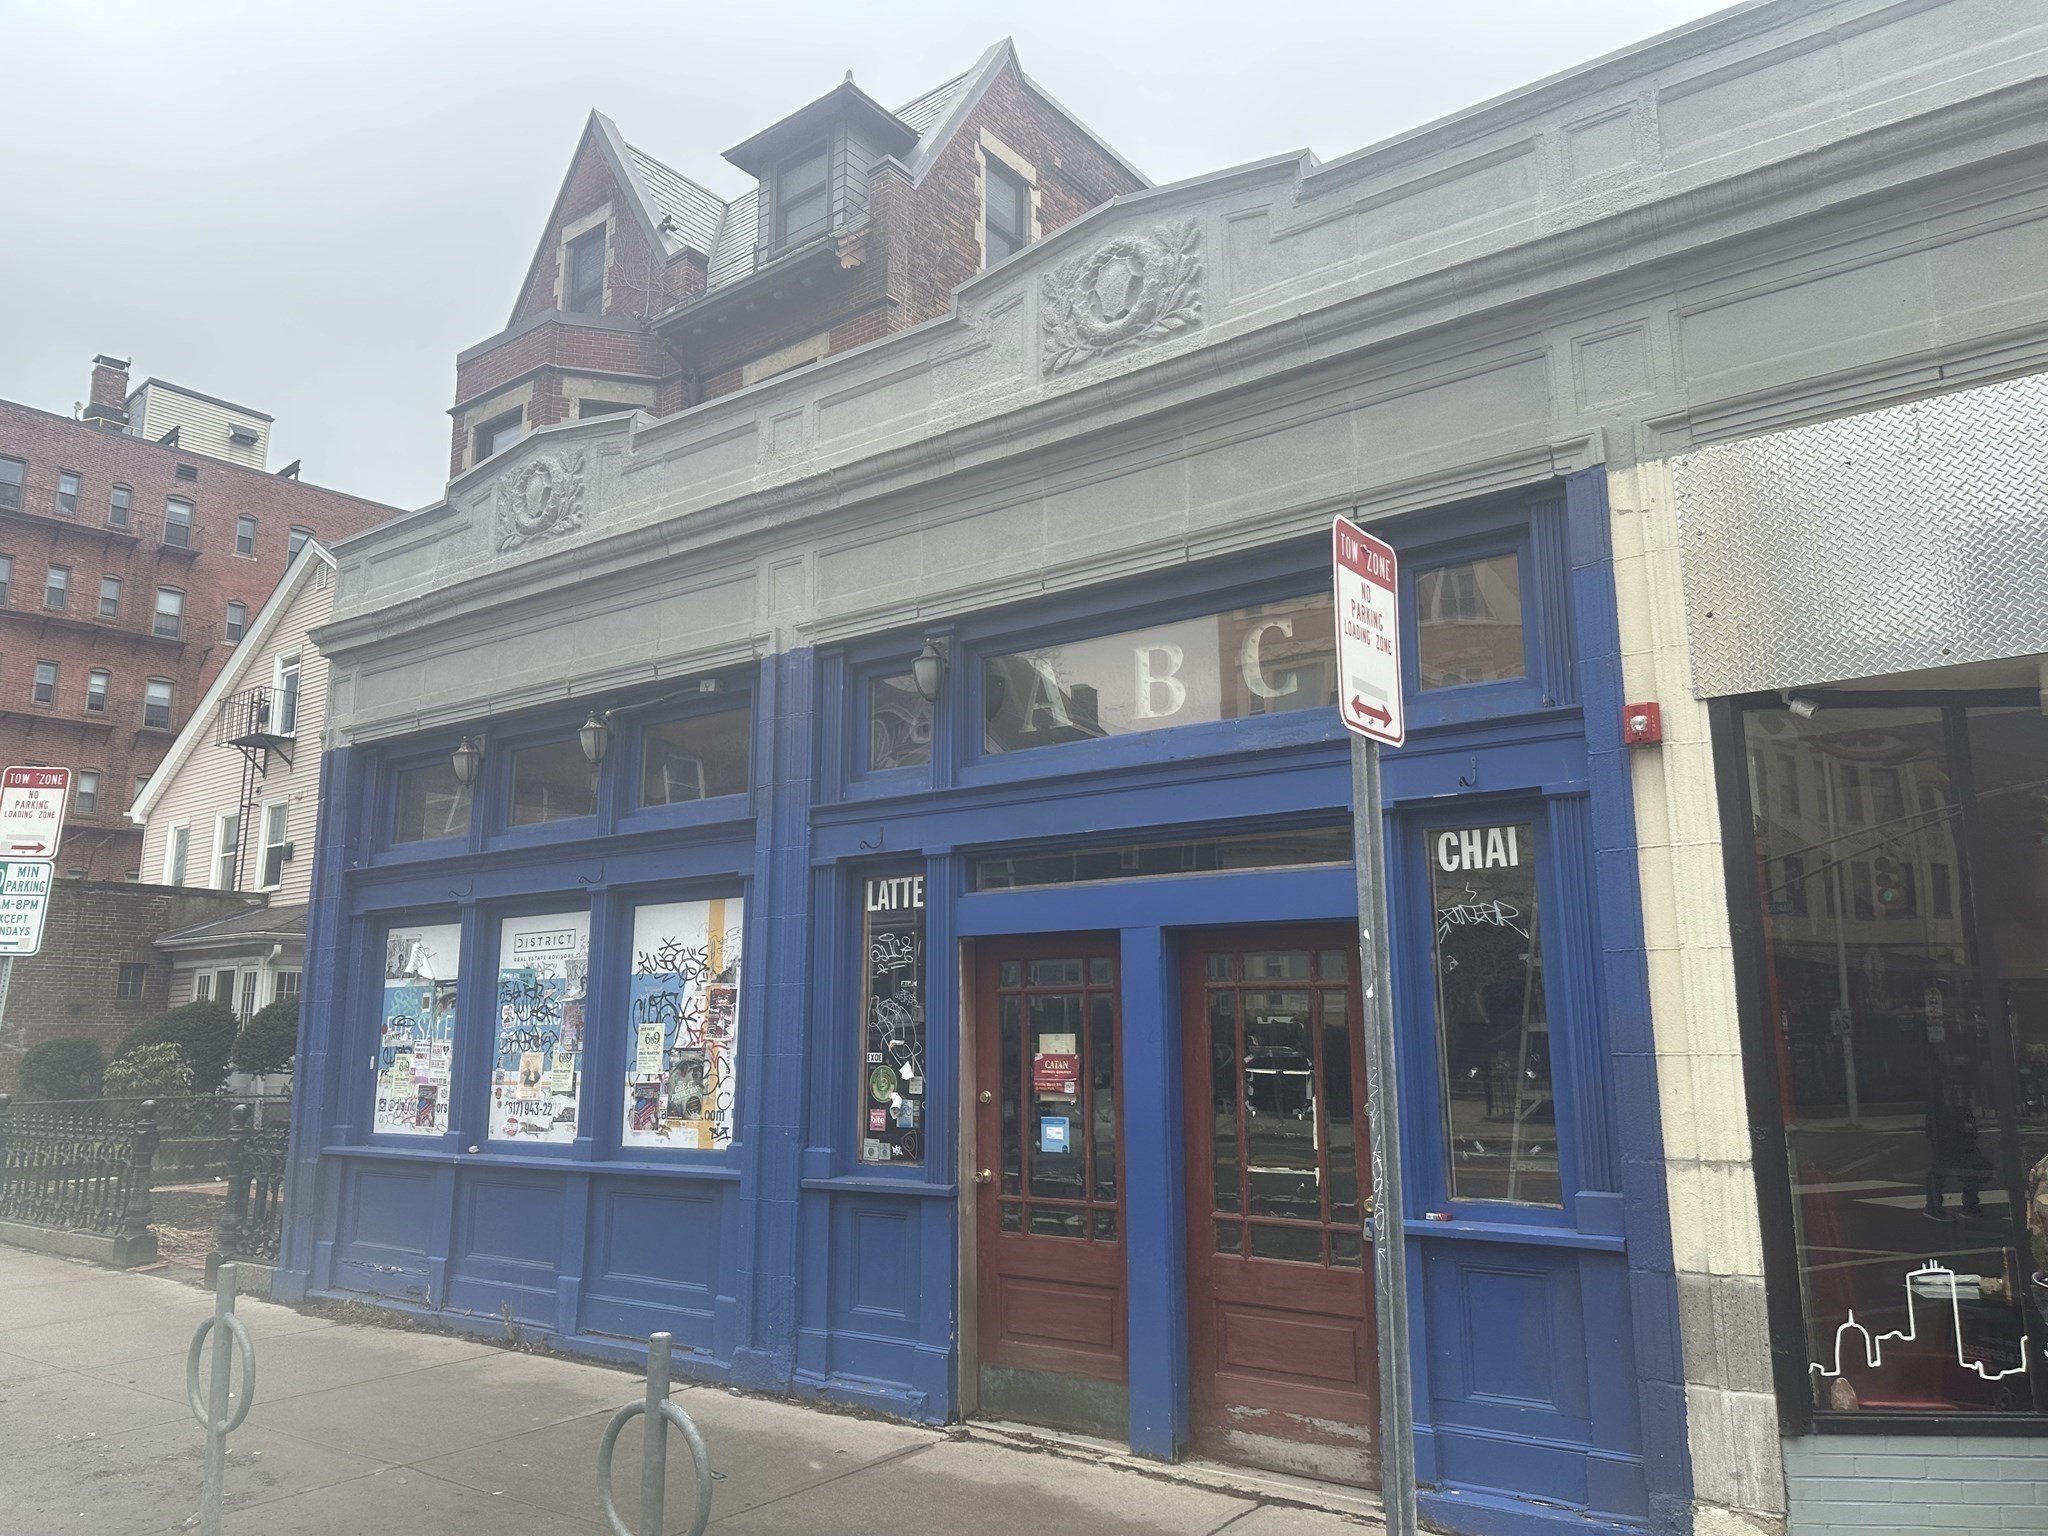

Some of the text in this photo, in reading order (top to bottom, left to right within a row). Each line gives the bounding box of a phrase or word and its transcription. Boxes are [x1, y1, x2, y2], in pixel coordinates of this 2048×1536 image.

[1340, 532, 1391, 582] TOW ZONE
[1361, 581, 1371, 603] NO
[1351, 599, 1384, 631] PARKING
[1344, 618, 1392, 656] LOADING ZONE
[9, 773, 64, 785] TOW ZONE
[28, 790, 39, 799] NO
[14, 800, 49, 810] PARKING
[4, 811, 55, 819] LOADING ZONE
[1438, 826, 1518, 872] CHAI
[17, 866, 40, 878] MIN
[5, 880, 46, 893] PARKING
[867, 876, 924, 911] LATTE
[0, 899, 39, 910] M-8PM
[517, 934, 572, 948] DISTRICT
[1044, 1060, 1069, 1069] CATAN
[524, 1101, 561, 1116] 943-22
